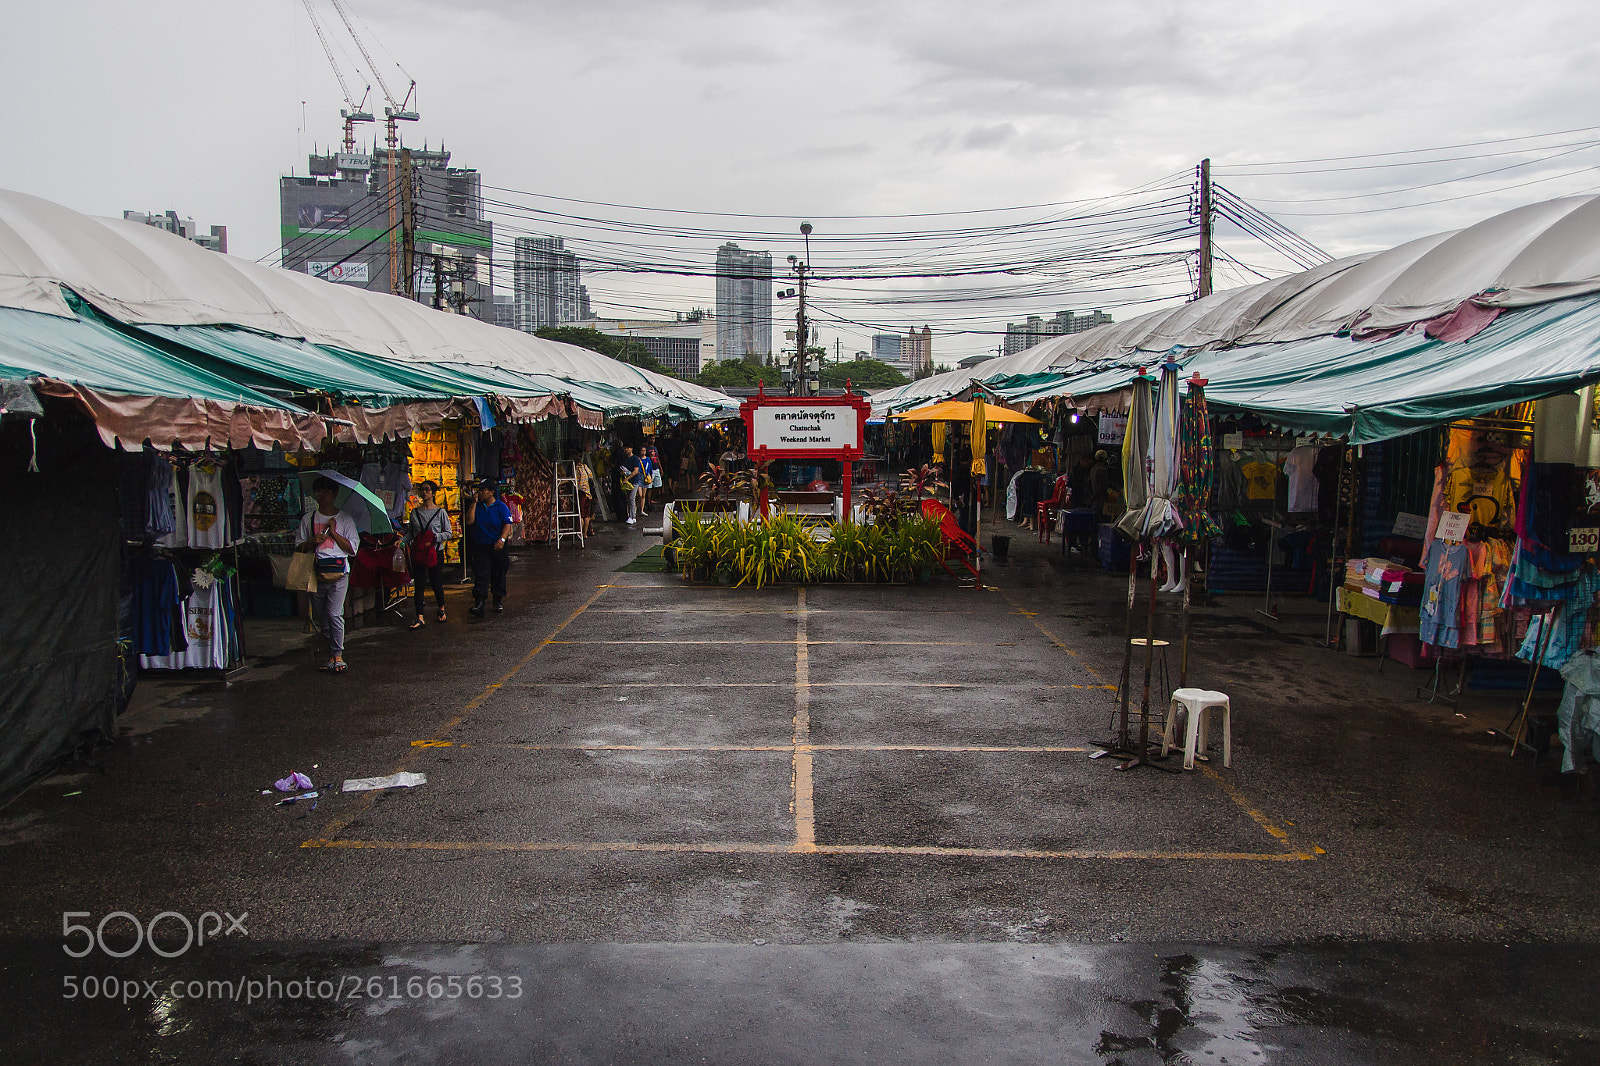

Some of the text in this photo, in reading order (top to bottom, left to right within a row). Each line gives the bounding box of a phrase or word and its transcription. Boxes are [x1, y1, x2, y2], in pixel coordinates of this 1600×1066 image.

[774, 409, 836, 424] ตลาดนัดจตุจักร
[789, 424, 822, 432] Chatuchak
[1570, 533, 1598, 546] 130
